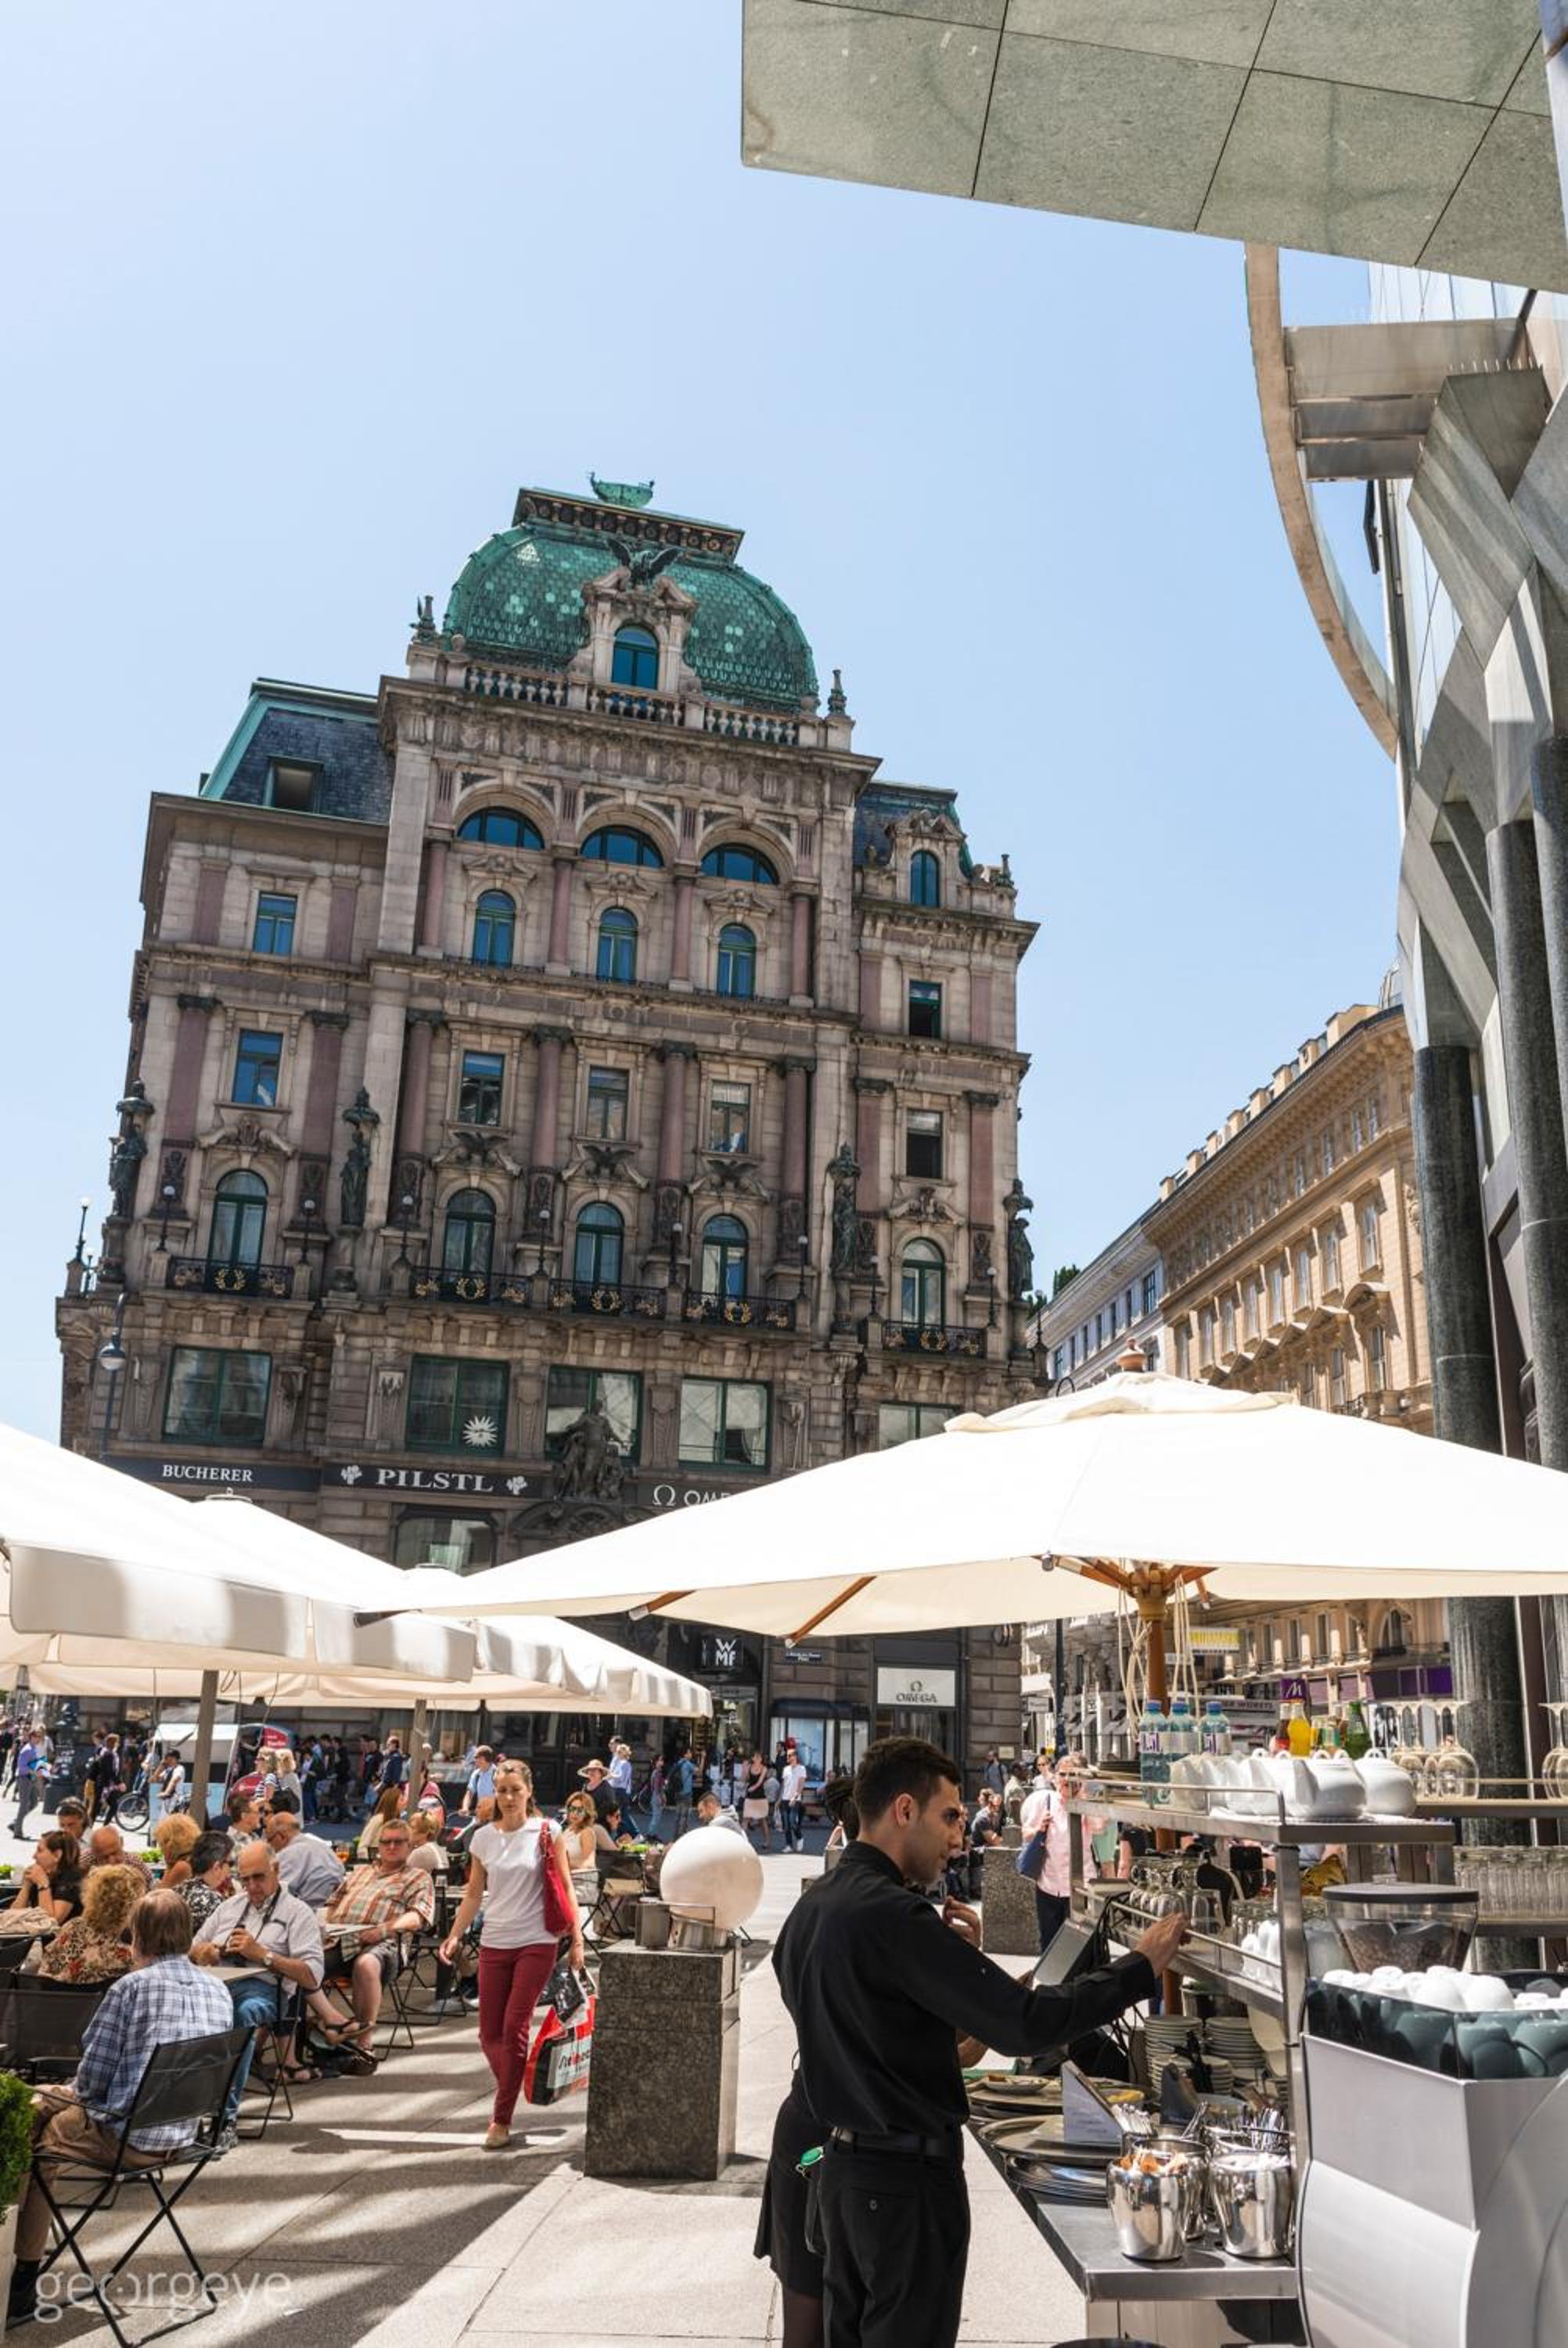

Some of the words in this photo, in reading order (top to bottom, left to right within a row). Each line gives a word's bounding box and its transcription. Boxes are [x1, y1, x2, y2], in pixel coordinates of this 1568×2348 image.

[162, 1464, 253, 1482] BUCHERER
[376, 1468, 494, 1492] PILSTL
[896, 1692, 937, 1703] OMEGA
